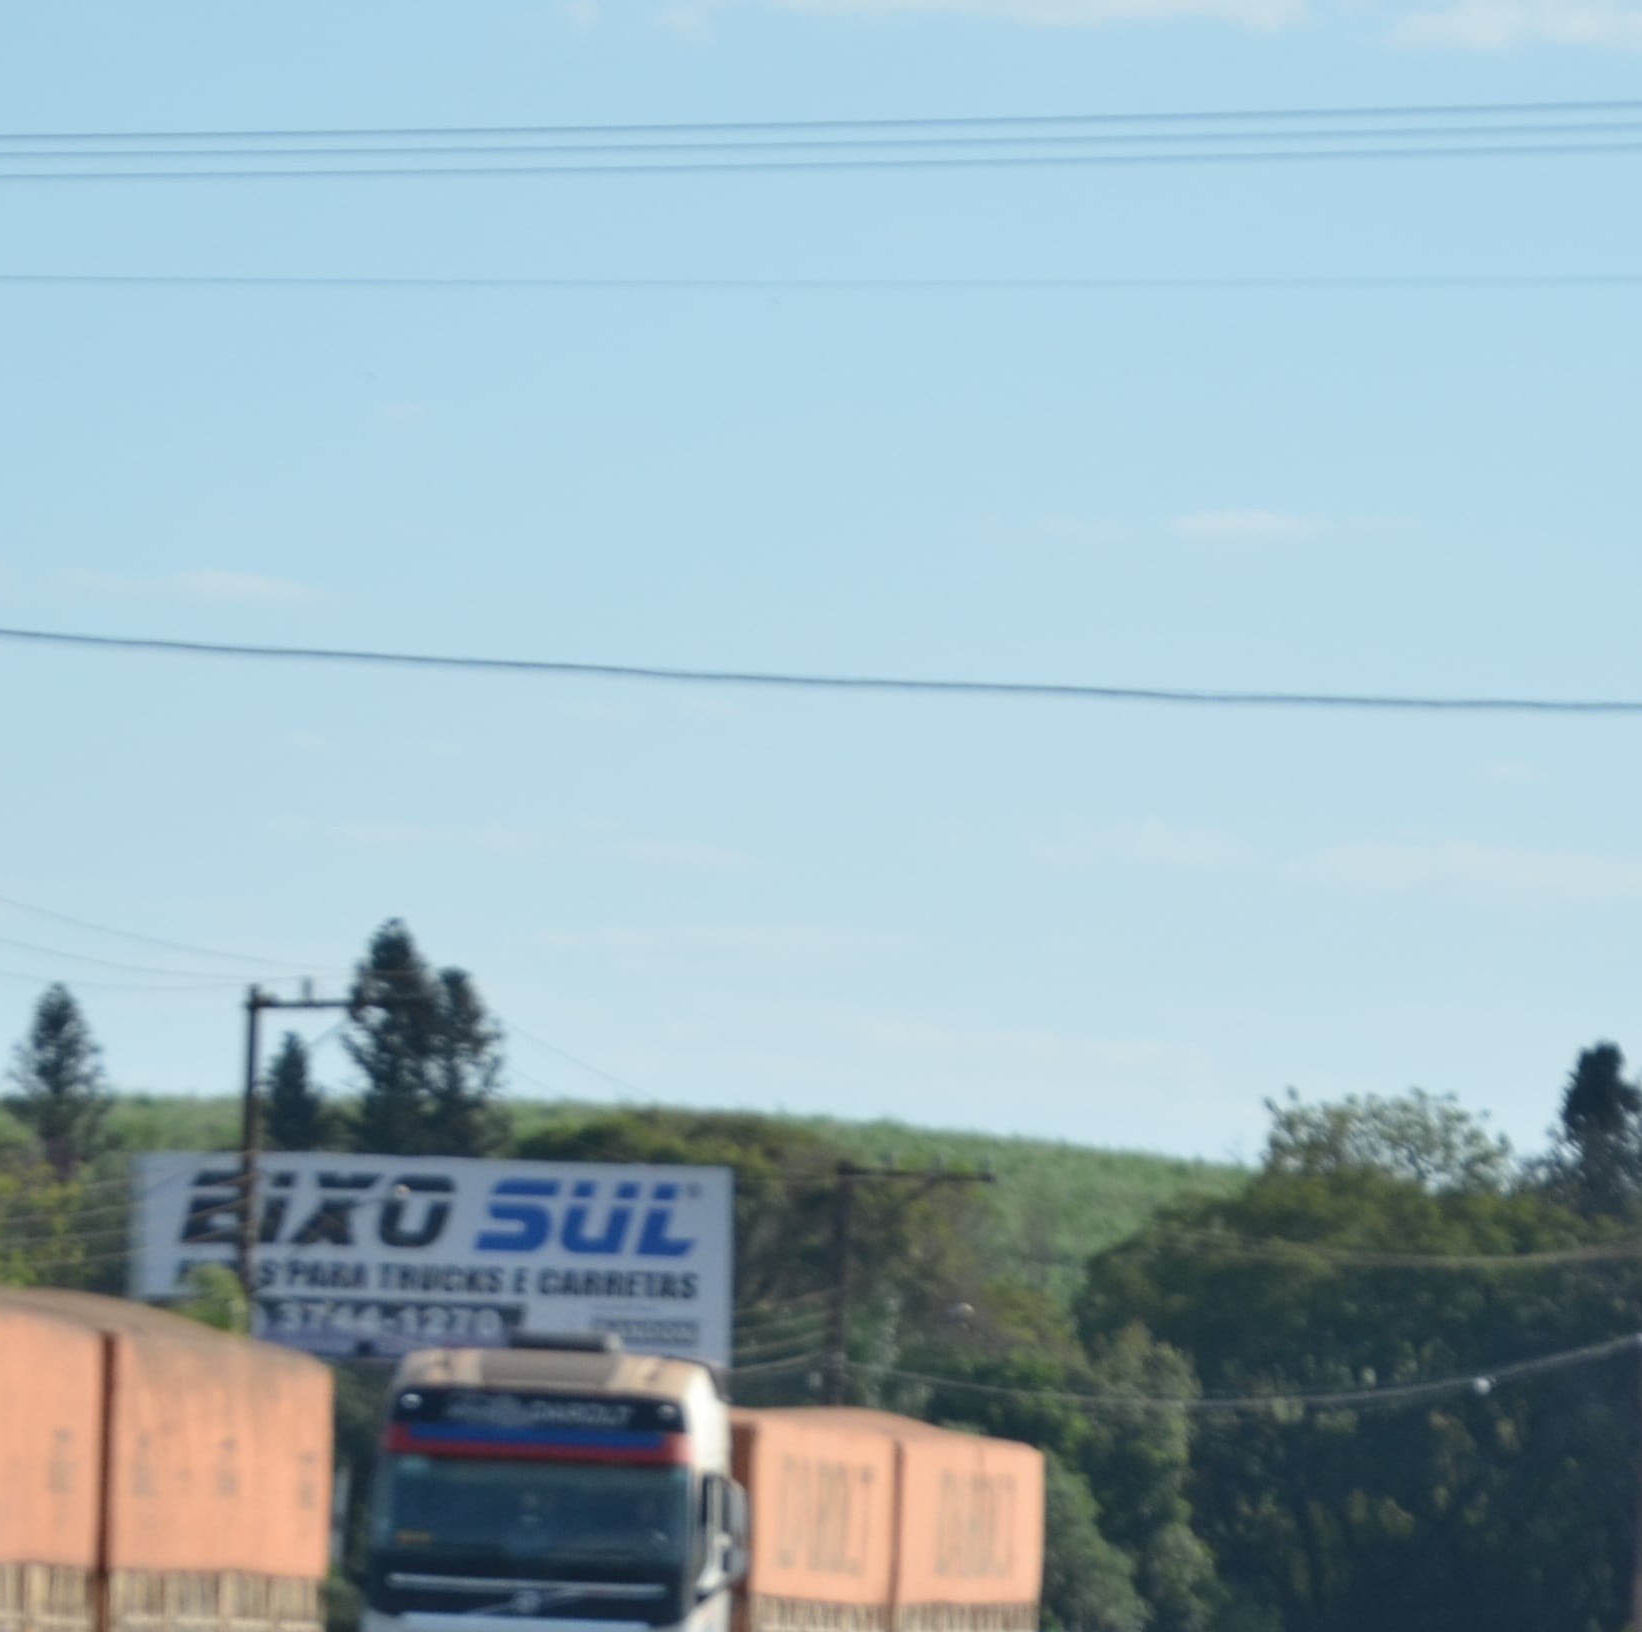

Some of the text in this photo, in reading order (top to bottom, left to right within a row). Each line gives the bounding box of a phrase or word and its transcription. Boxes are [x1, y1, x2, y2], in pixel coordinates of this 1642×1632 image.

[474, 1178, 695, 1257] SUL
[287, 1260, 367, 1289] PARA
[377, 1262, 504, 1293] TRUCKS
[513, 1266, 530, 1293] E
[537, 1266, 700, 1298] CARRETAS
